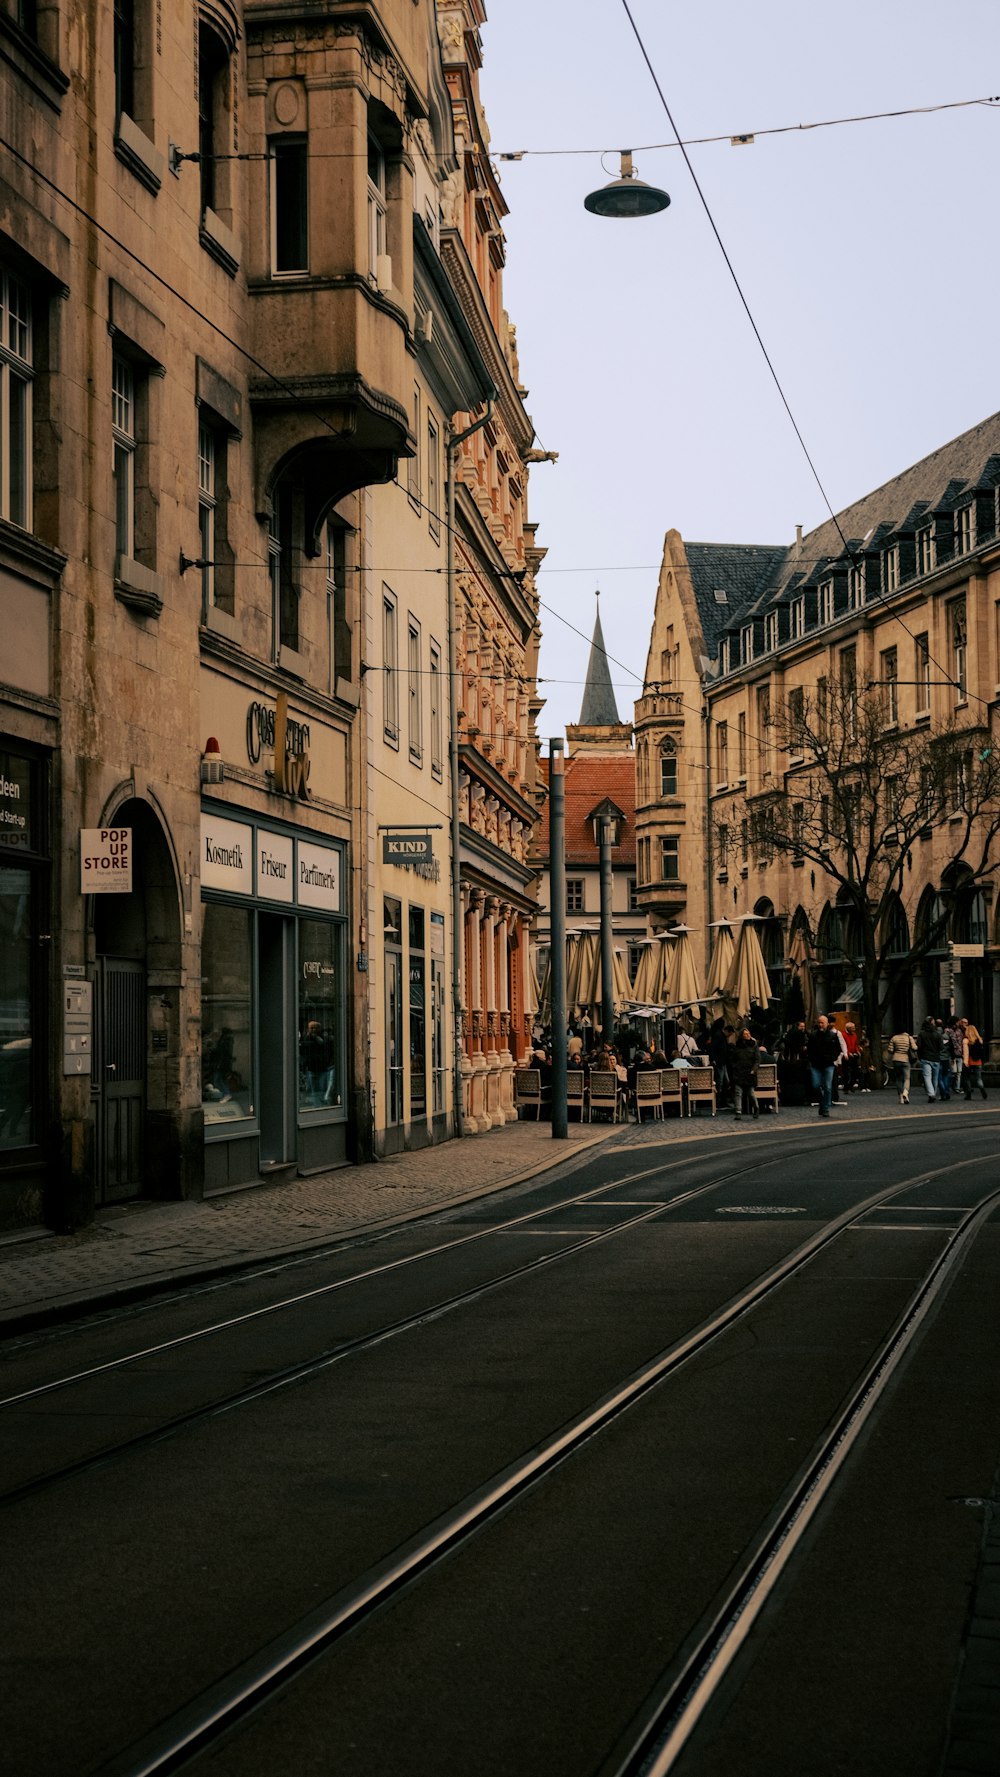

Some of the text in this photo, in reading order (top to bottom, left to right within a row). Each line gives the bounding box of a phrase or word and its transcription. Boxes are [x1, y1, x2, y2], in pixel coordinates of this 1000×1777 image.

[5, 810, 26, 829] Start-up
[100, 830, 128, 843] POP
[109, 843, 128, 856] UP
[387, 841, 428, 853] KIND
[84, 856, 128, 870] STORE
[205, 837, 335, 890] Kosmetik Friseur Parfümerie
